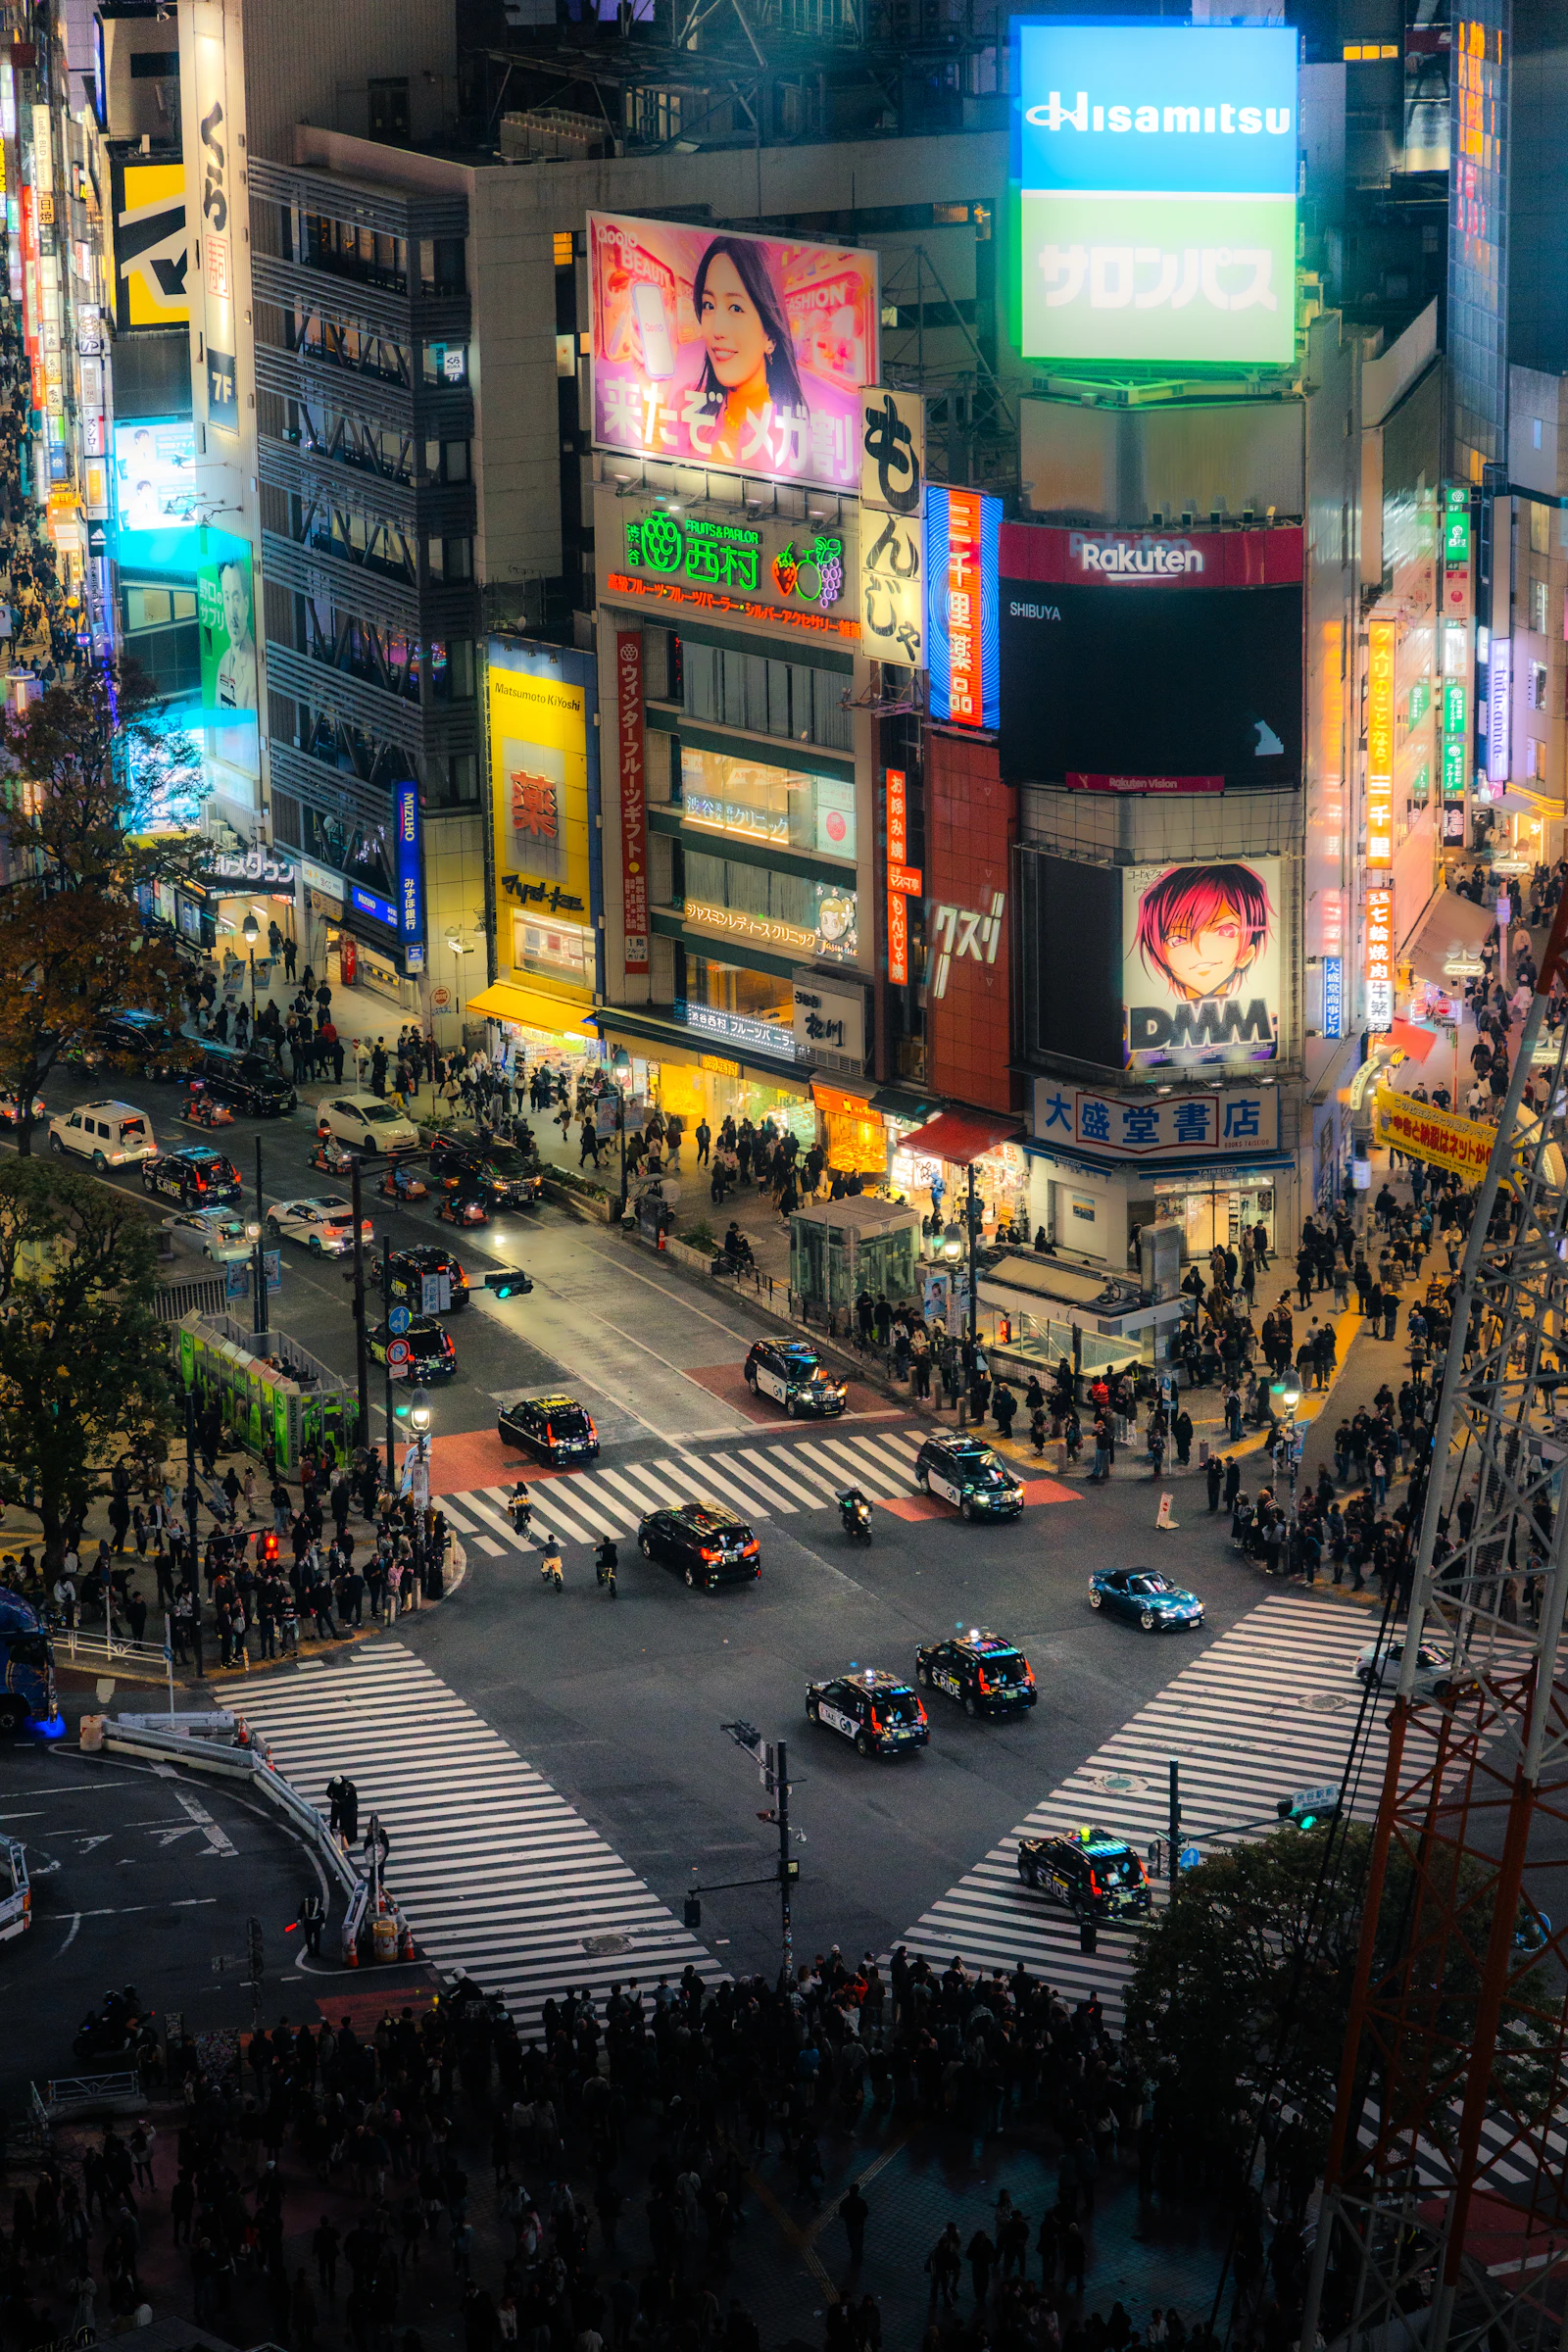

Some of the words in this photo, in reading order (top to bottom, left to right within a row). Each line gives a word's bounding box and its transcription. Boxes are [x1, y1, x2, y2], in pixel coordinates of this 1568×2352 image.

[1025, 91, 1291, 135] Hisamitsu
[596, 225, 639, 248] Qoo10
[1039, 244, 1278, 312] サロンパス
[212, 371, 233, 405] 7F
[626, 521, 641, 566] 渋谷
[862, 393, 922, 663] もんじゃ
[685, 535, 759, 592] 西村
[1083, 543, 1204, 573] Rakuten
[949, 505, 973, 715] 三千里薬品
[1009, 601, 1062, 621] SHIBUYA
[495, 682, 546, 706] Matsumoto
[547, 691, 581, 712] KiYoshi
[1372, 628, 1391, 763] クスリのことなら
[510, 769, 559, 840] 薬
[1108, 777, 1148, 789] Rakuten
[1149, 778, 1178, 789] Vision
[403, 792, 416, 842] MIZUHO
[403, 878, 416, 930] みずほ銀行
[1368, 906, 1390, 980] 七輪焼肉
[1130, 997, 1276, 1053] DMM
[1045, 1092, 1262, 1144] 大盛堂書店
[1053, 1155, 1082, 1169] TAISEIDO
[1198, 1167, 1238, 1176] TAISEIDO
[290, 1444, 299, 1468] AREA
